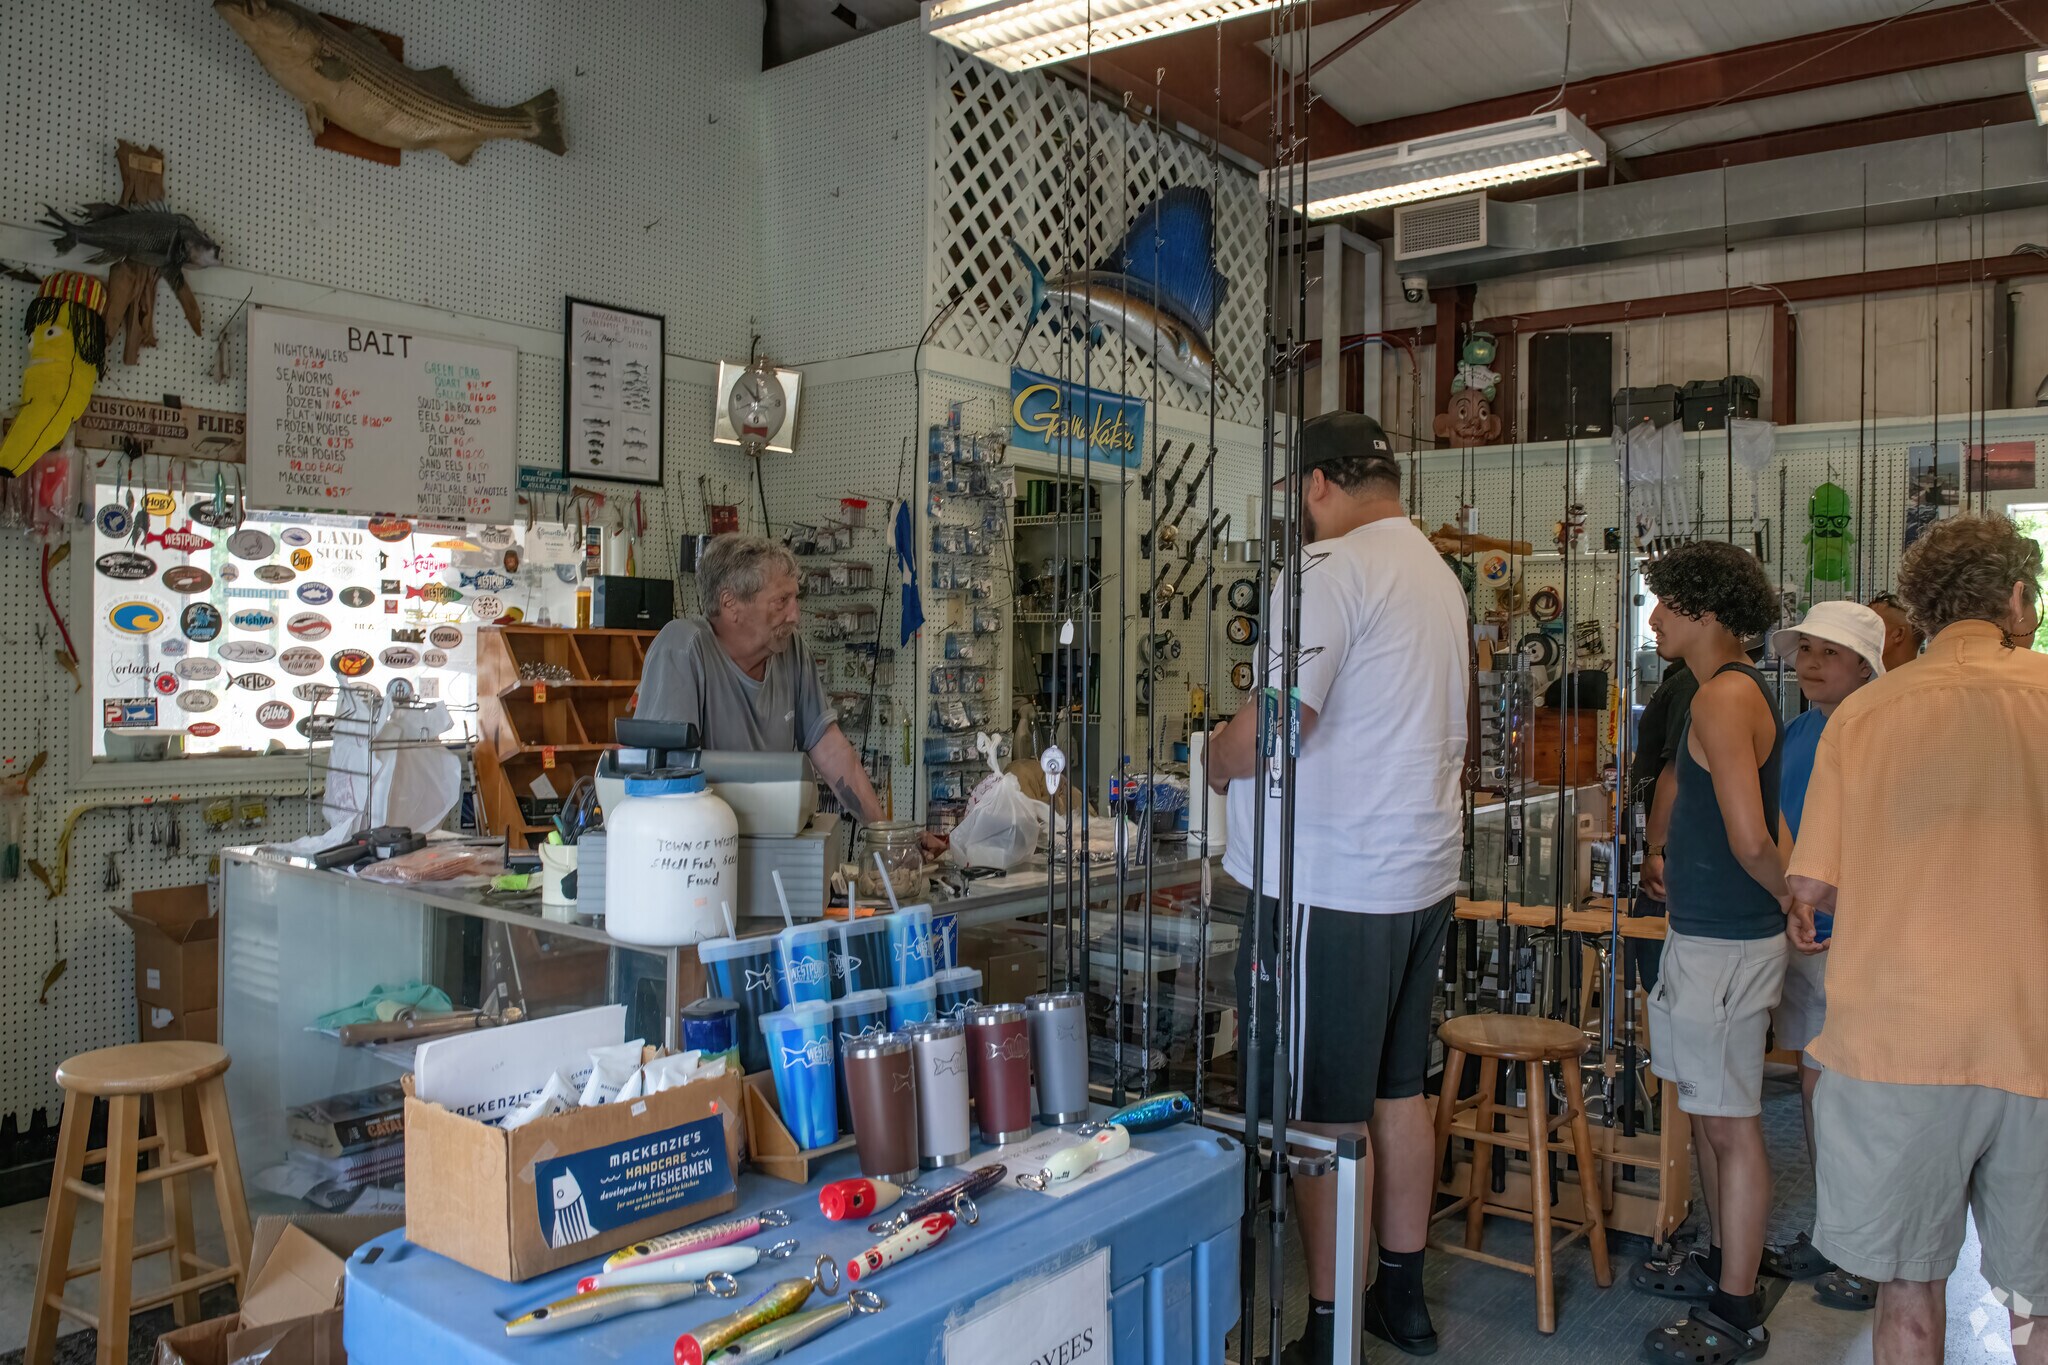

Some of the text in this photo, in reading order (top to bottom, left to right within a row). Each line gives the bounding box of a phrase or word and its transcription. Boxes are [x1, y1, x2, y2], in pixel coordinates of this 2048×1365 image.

[348, 326, 412, 359] BAIT
[274, 343, 348, 363] NIGHTCRAWLERS
[276, 367, 333, 386] SEAWORMS
[424, 361, 480, 379] GREEN CRAB
[299, 384, 330, 398] DOZEN
[286, 395, 322, 409] DOZEN
[89, 402, 180, 423] CUSTOM TIED
[418, 410, 440, 422] EELS
[464, 417, 481, 425] each
[84, 417, 186, 437] AVAILABLE HERE
[197, 414, 244, 434] FLIES
[276, 419, 350, 437] FROZEN POGIES
[419, 421, 465, 436] SEA CLAMS
[285, 433, 322, 447] 2-PACK
[428, 434, 449, 446] PINT
[277, 445, 346, 462] FRESH POGIES
[428, 445, 452, 458] QUART
[320, 463, 344, 474] EACH
[420, 456, 441, 470] SAND
[445, 460, 463, 472] EELS
[279, 471, 329, 485] MACKEREL
[418, 469, 486, 484] OFFSHORE BAIT
[286, 484, 321, 496] 2-PACK
[424, 482, 468, 494] AVAILABLE
[146, 496, 172, 509] Hogy
[417, 494, 441, 506] NATIVE
[165, 532, 205, 547] WESTPORT
[317, 530, 363, 545] LAND
[291, 552, 312, 568] Buff
[316, 548, 362, 560] SUCKS
[477, 575, 506, 589] WESTPORT
[223, 588, 286, 599] SHIMANO
[424, 587, 455, 598] WESTPORT
[260, 705, 289, 723] Gibbs
[657, 838, 692, 852] TOWN
[695, 840, 711, 850] OF
[609, 1130, 701, 1168] MACKENZIE'S
[625, 1151, 687, 1180] HANDCARE
[600, 1158, 713, 1201] developed by FISHERMEN
[680, 1179, 699, 1190] kitchen
[666, 1192, 684, 1203] garden
